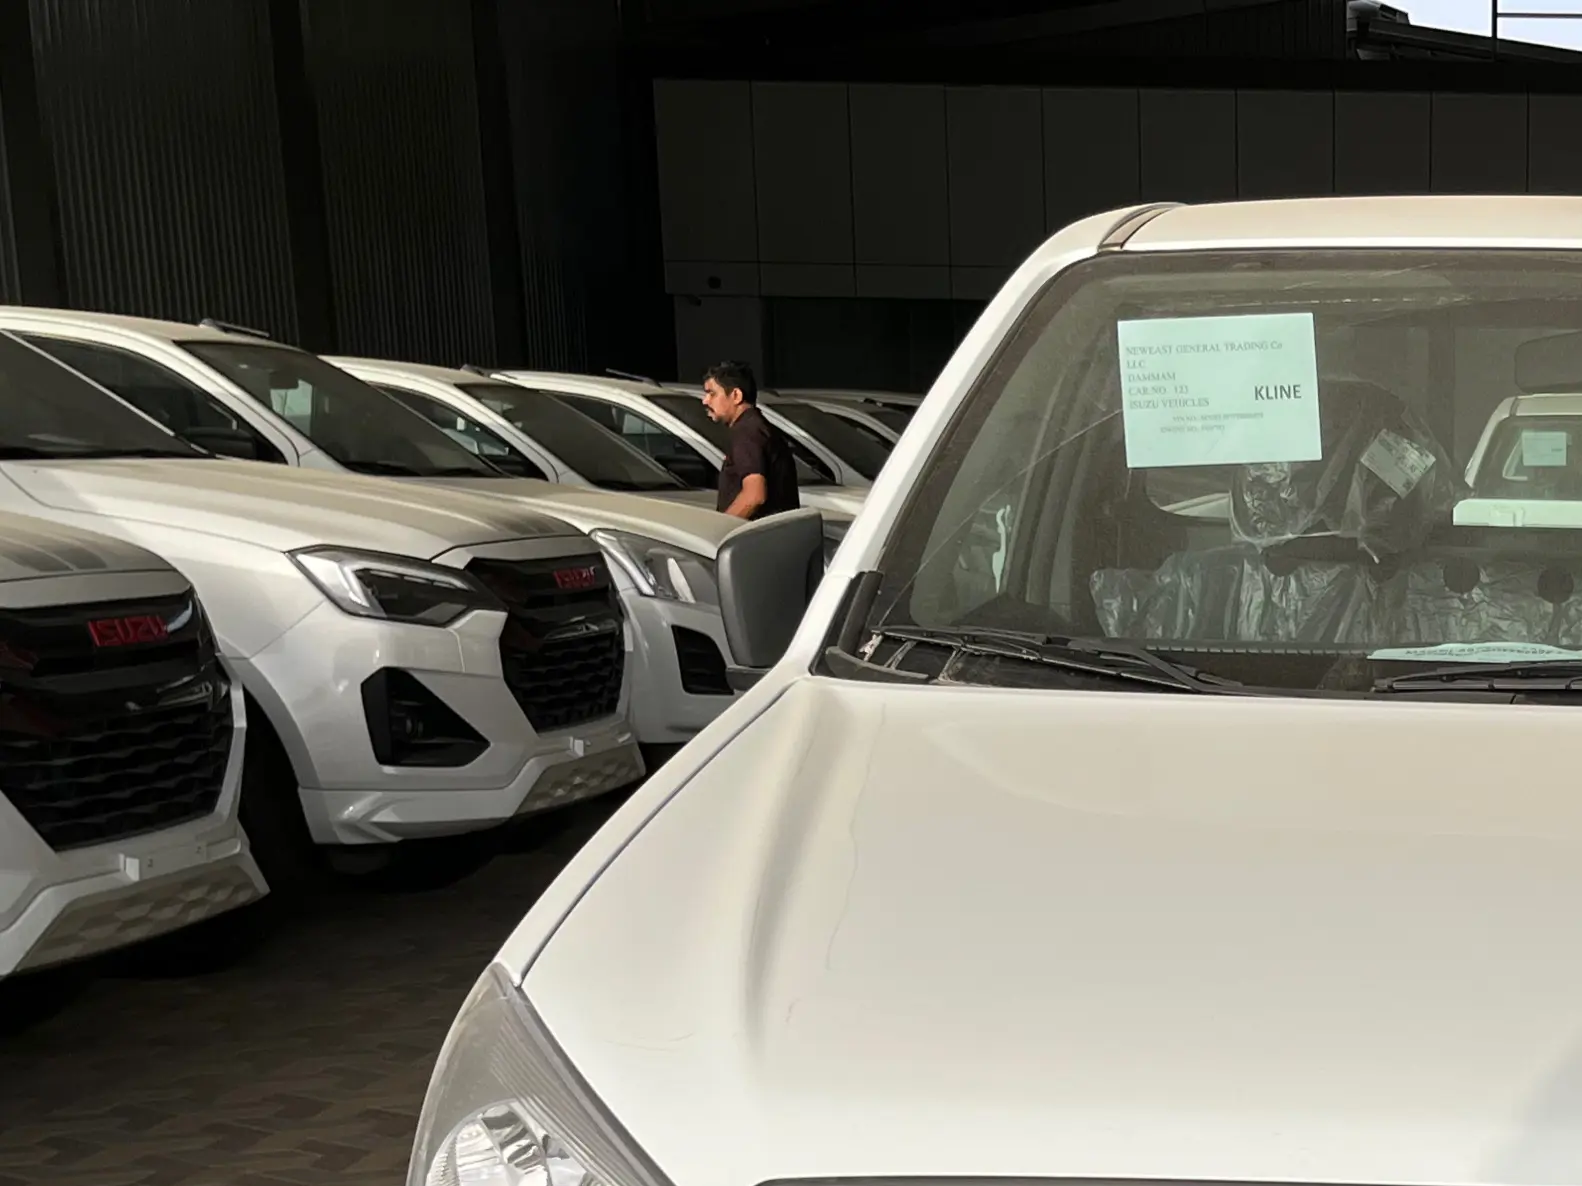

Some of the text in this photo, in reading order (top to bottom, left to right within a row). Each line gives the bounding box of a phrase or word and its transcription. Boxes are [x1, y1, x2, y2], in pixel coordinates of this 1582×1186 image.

[1176, 344, 1220, 355] GENERAL
[1224, 342, 1268, 352] TRADING
[1127, 360, 1146, 369] LLC
[1128, 372, 1176, 383] DAMMAM
[1254, 384, 1302, 401] KLINE
[1129, 397, 1210, 410] ISUZU VEHICLES
[88, 615, 169, 647] ISUZU
